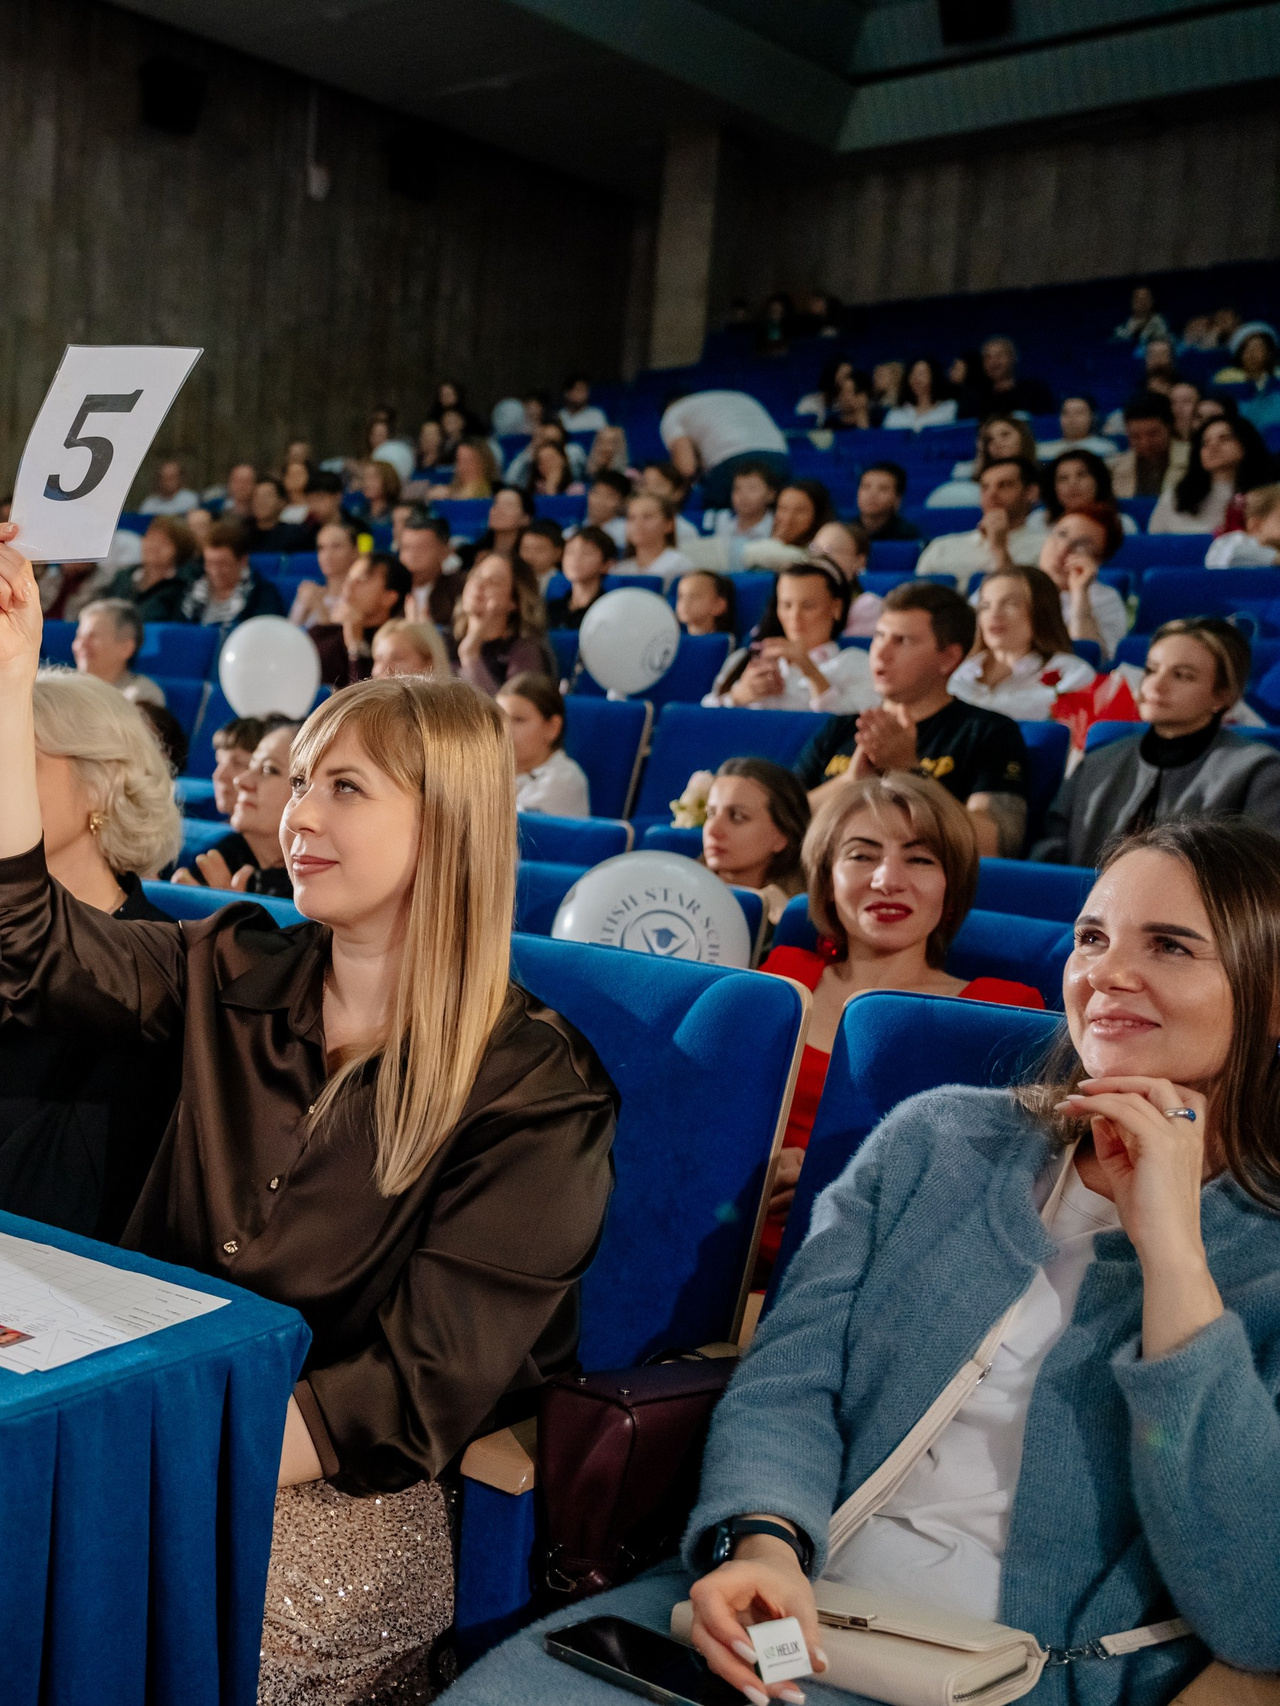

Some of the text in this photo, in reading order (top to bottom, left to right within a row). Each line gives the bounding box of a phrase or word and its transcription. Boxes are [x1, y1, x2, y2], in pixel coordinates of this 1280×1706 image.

[43, 389, 144, 501] 5
[644, 887, 702, 916] STAR
[776, 1641, 801, 1657] HELIX
